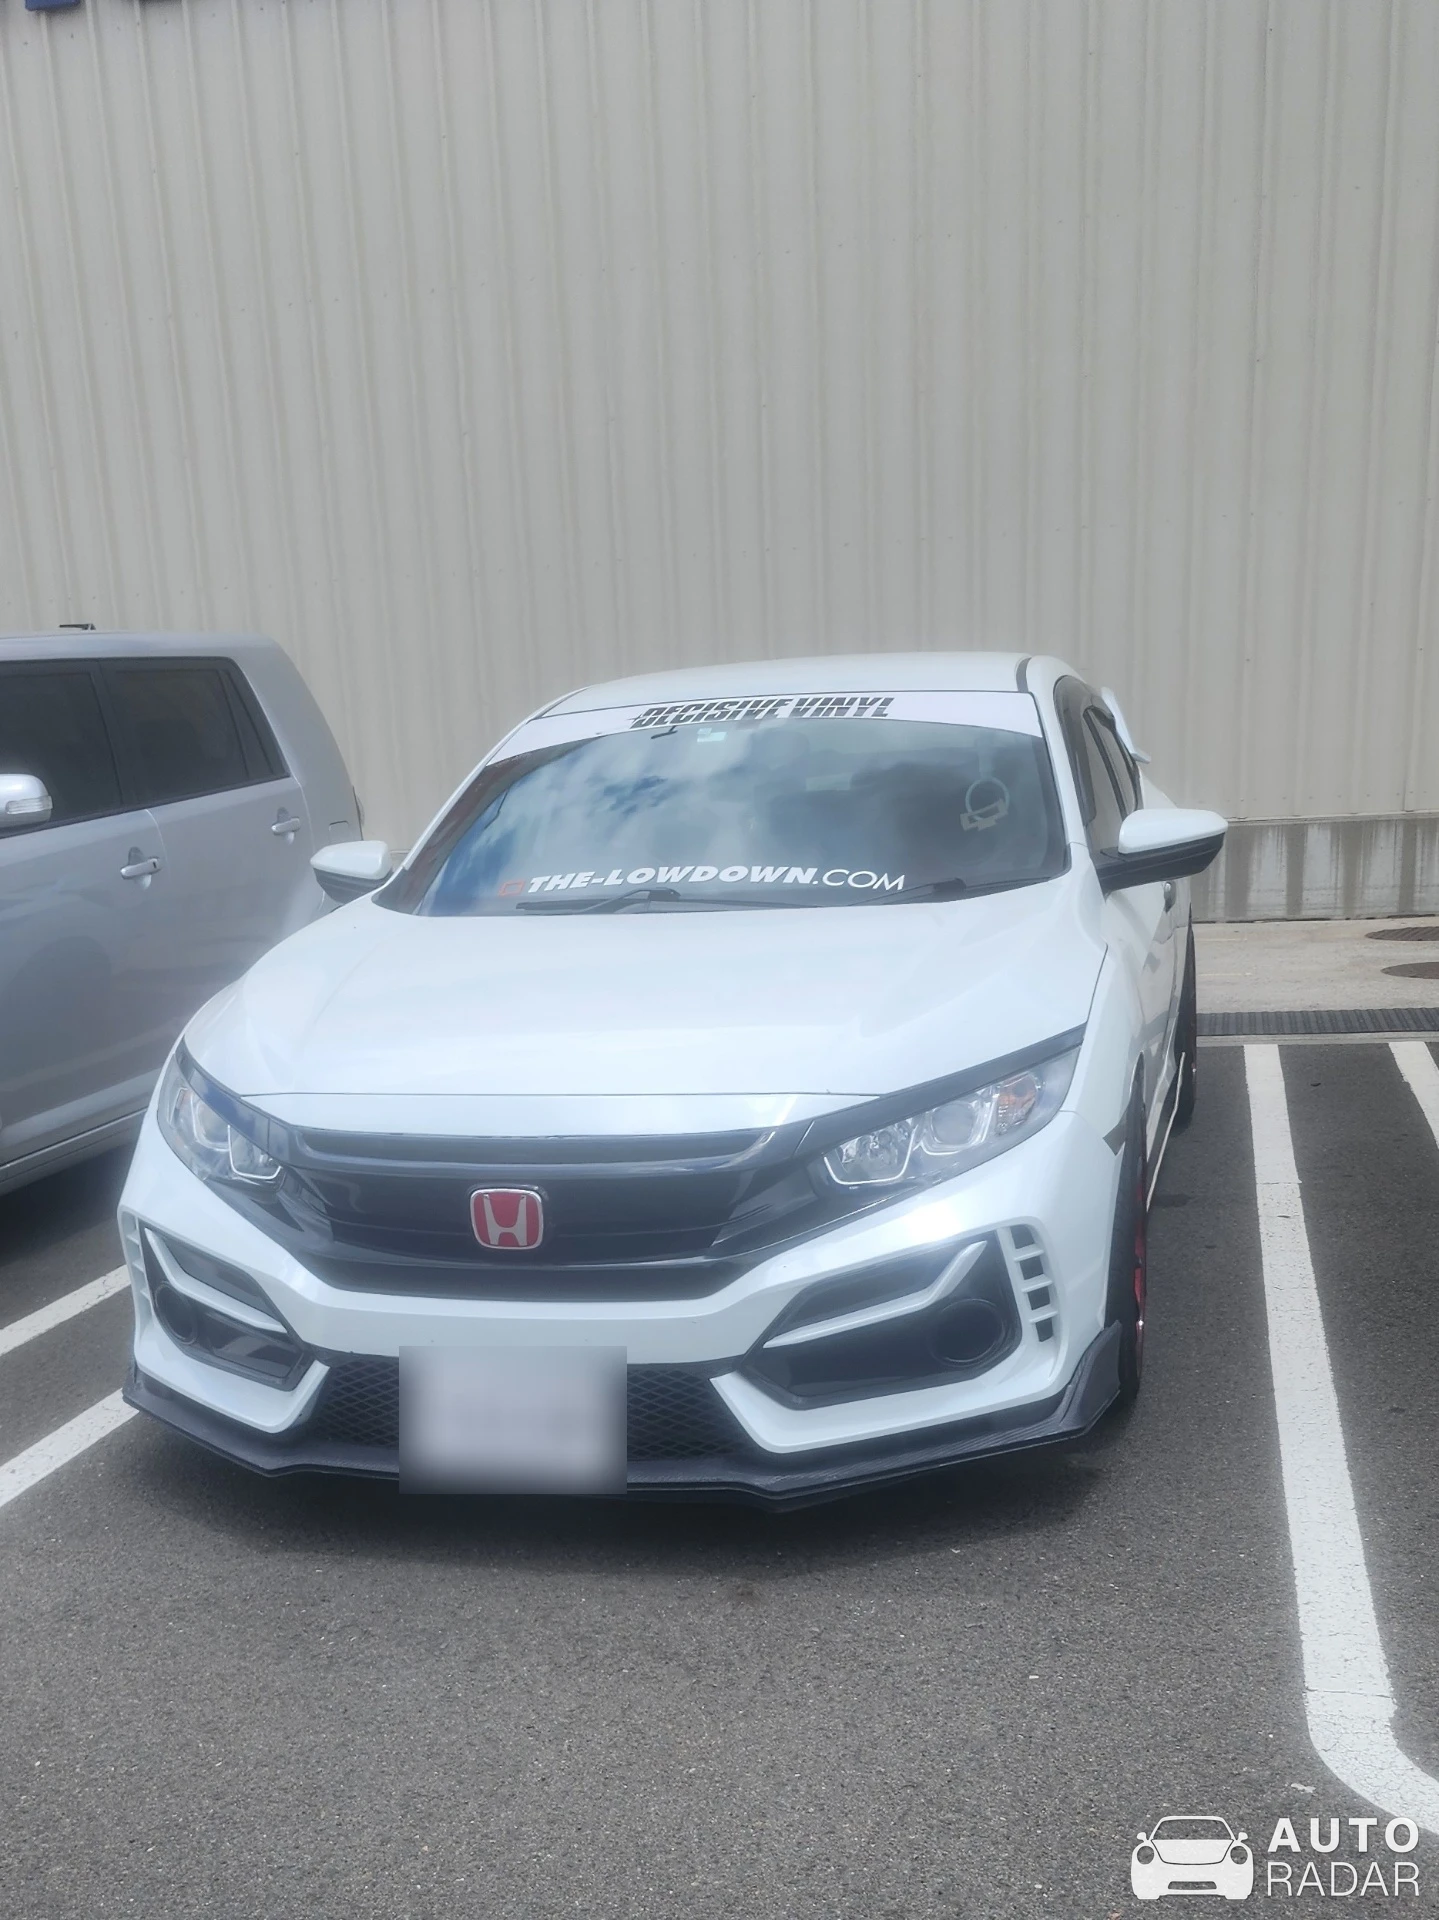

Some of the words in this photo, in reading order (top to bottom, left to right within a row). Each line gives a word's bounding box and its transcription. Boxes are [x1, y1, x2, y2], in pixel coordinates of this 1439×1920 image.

[629, 699, 794, 729] DECISIVE
[789, 697, 895, 718] VINYL
[528, 865, 905, 893] THE-LOWDOWN.COM
